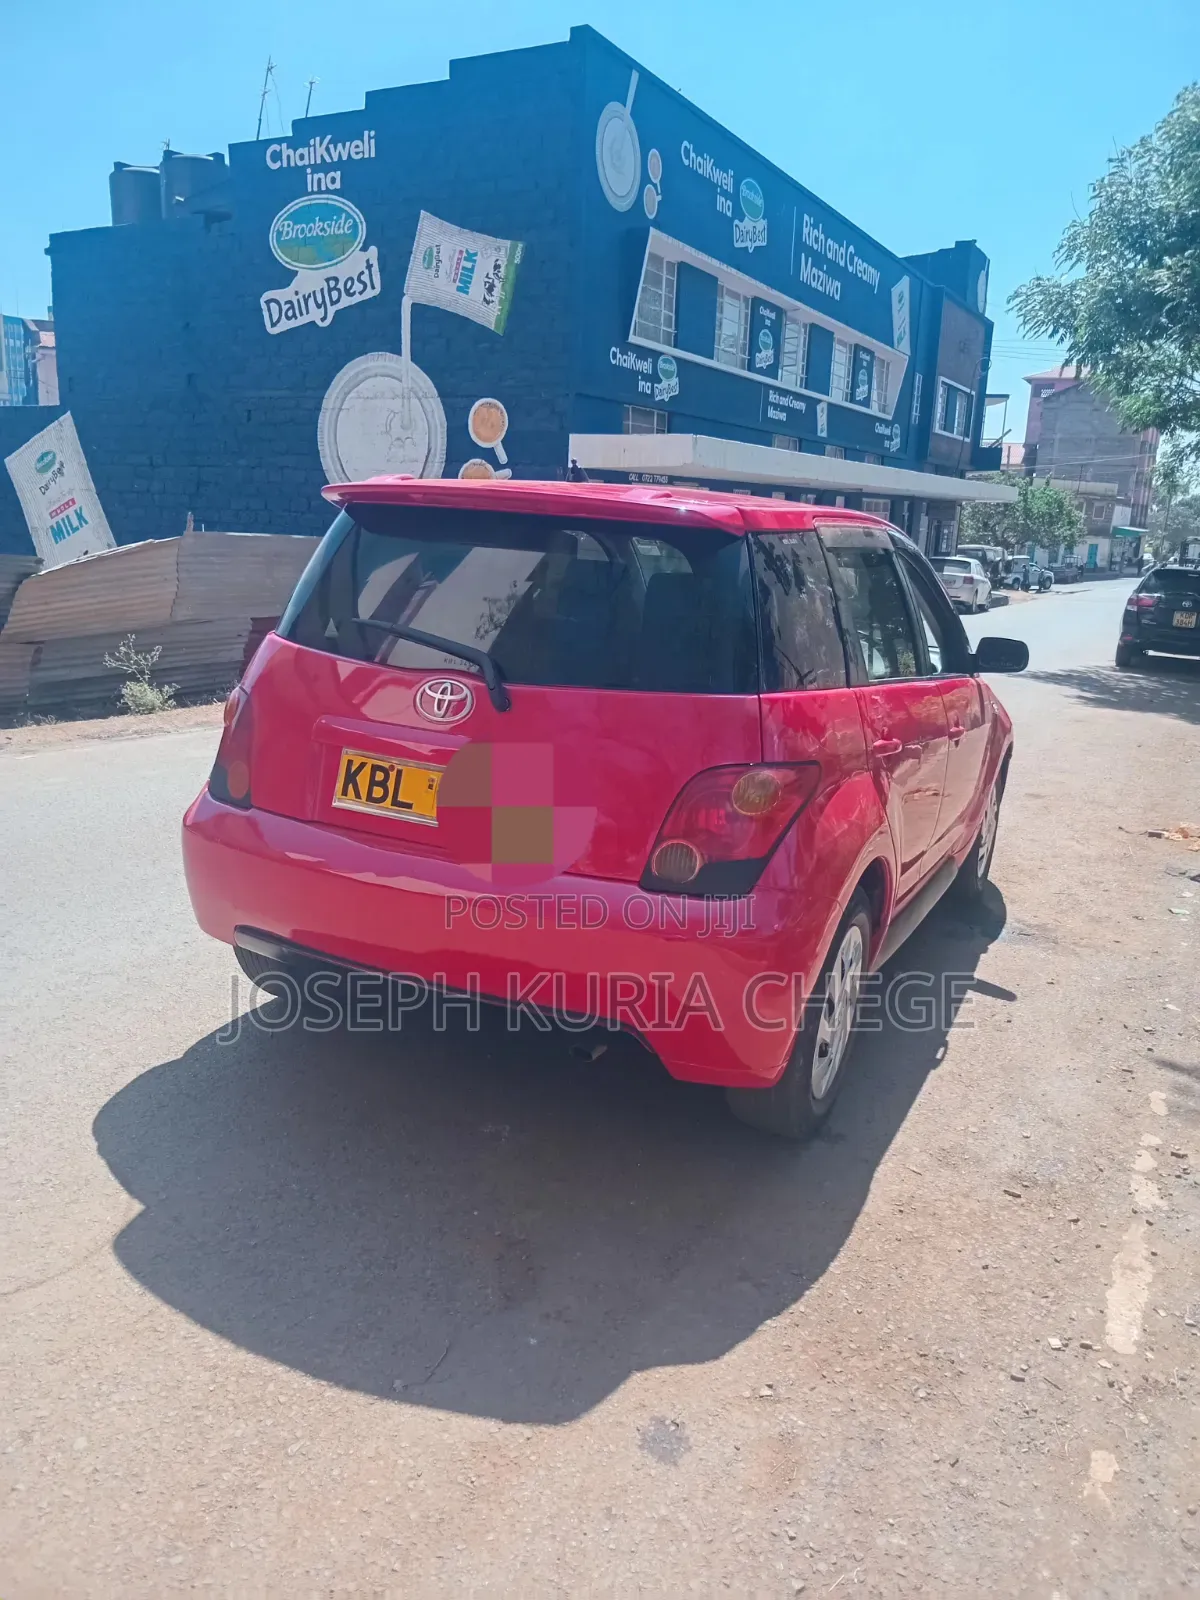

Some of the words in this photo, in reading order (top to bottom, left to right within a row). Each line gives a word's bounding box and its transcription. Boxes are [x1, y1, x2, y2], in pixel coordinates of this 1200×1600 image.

[266, 130, 375, 170] ChaiKweli
[681, 140, 734, 194] ChaiKweli
[306, 168, 341, 192] ina
[716, 187, 733, 218] ina
[279, 213, 354, 241] Brookside
[735, 223, 766, 249] DairyBest
[456, 248, 478, 296] MILK
[803, 213, 825, 255] Rich
[826, 239, 847, 268] and
[847, 245, 880, 295] Creamy
[264, 258, 376, 328] DairyBest
[800, 252, 841, 301] Maziwa
[609, 346, 653, 375] ChaiKweli
[638, 376, 651, 394] ina
[49, 505, 89, 545] MILK
[341, 759, 414, 810] KBL
